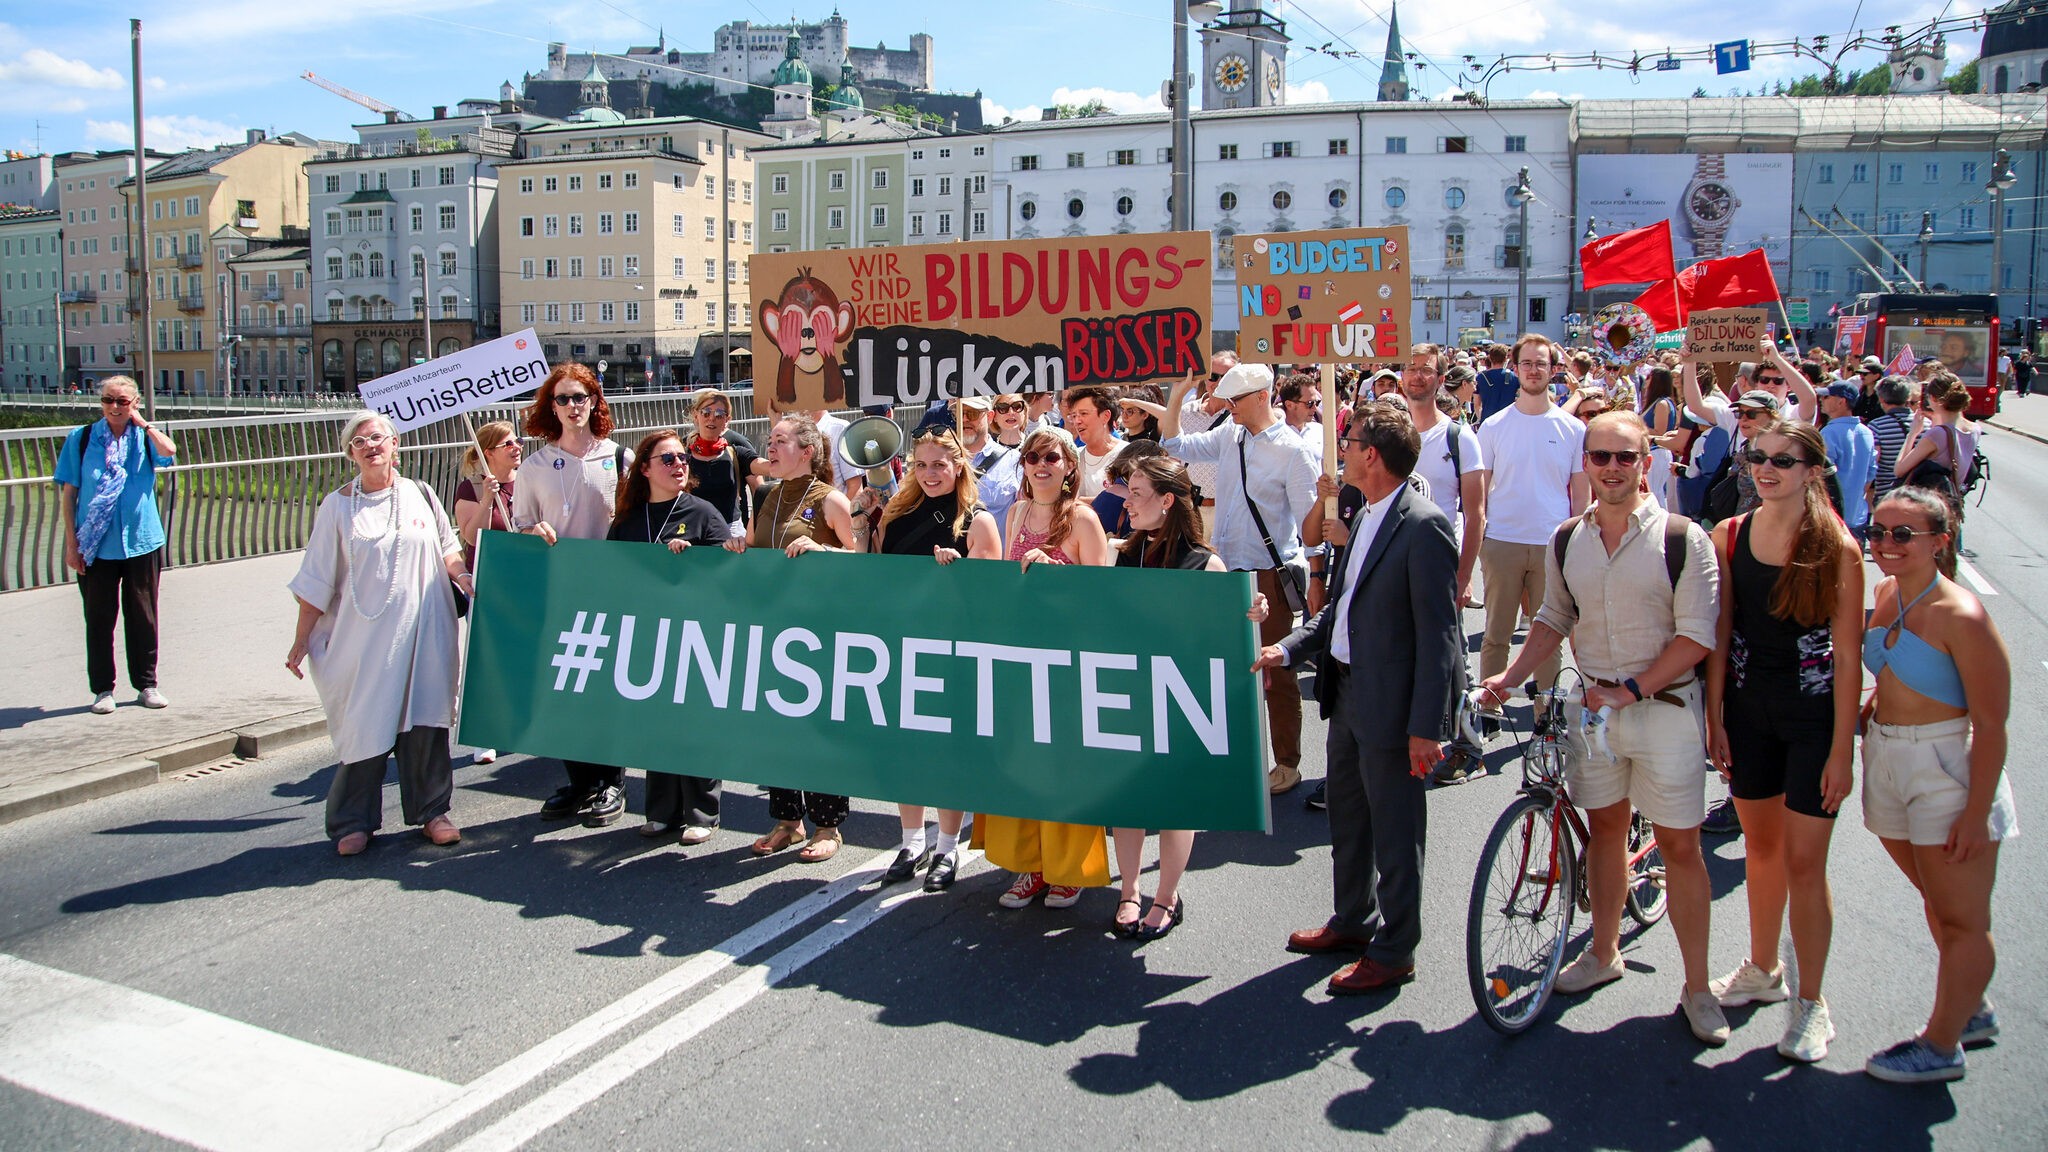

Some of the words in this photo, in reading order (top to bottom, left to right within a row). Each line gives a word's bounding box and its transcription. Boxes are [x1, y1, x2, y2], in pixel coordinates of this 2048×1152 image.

[1722, 45, 1741, 69] T
[848, 253, 901, 278] WIR
[1269, 237, 1386, 275] BUDGET
[851, 277, 911, 302] SIND
[925, 246, 1205, 322] BILDUNGS-
[1241, 284, 1281, 317] NO
[858, 301, 921, 326] KEINE
[1690, 315, 1718, 327] Reiche
[1734, 313, 1761, 324] Kasse
[1913, 317, 1919, 325] 3
[1272, 323, 1398, 358] FUTURE
[1693, 325, 1756, 341] BILDUNG
[1689, 341, 1706, 353] für
[1710, 341, 1724, 352] die
[1727, 341, 1755, 353] Masse
[366, 379, 412, 399] Universität
[413, 362, 462, 384] Mozarteum
[377, 359, 548, 422] #UnisRetten
[549, 610, 1229, 757] #UNISRETTEN
